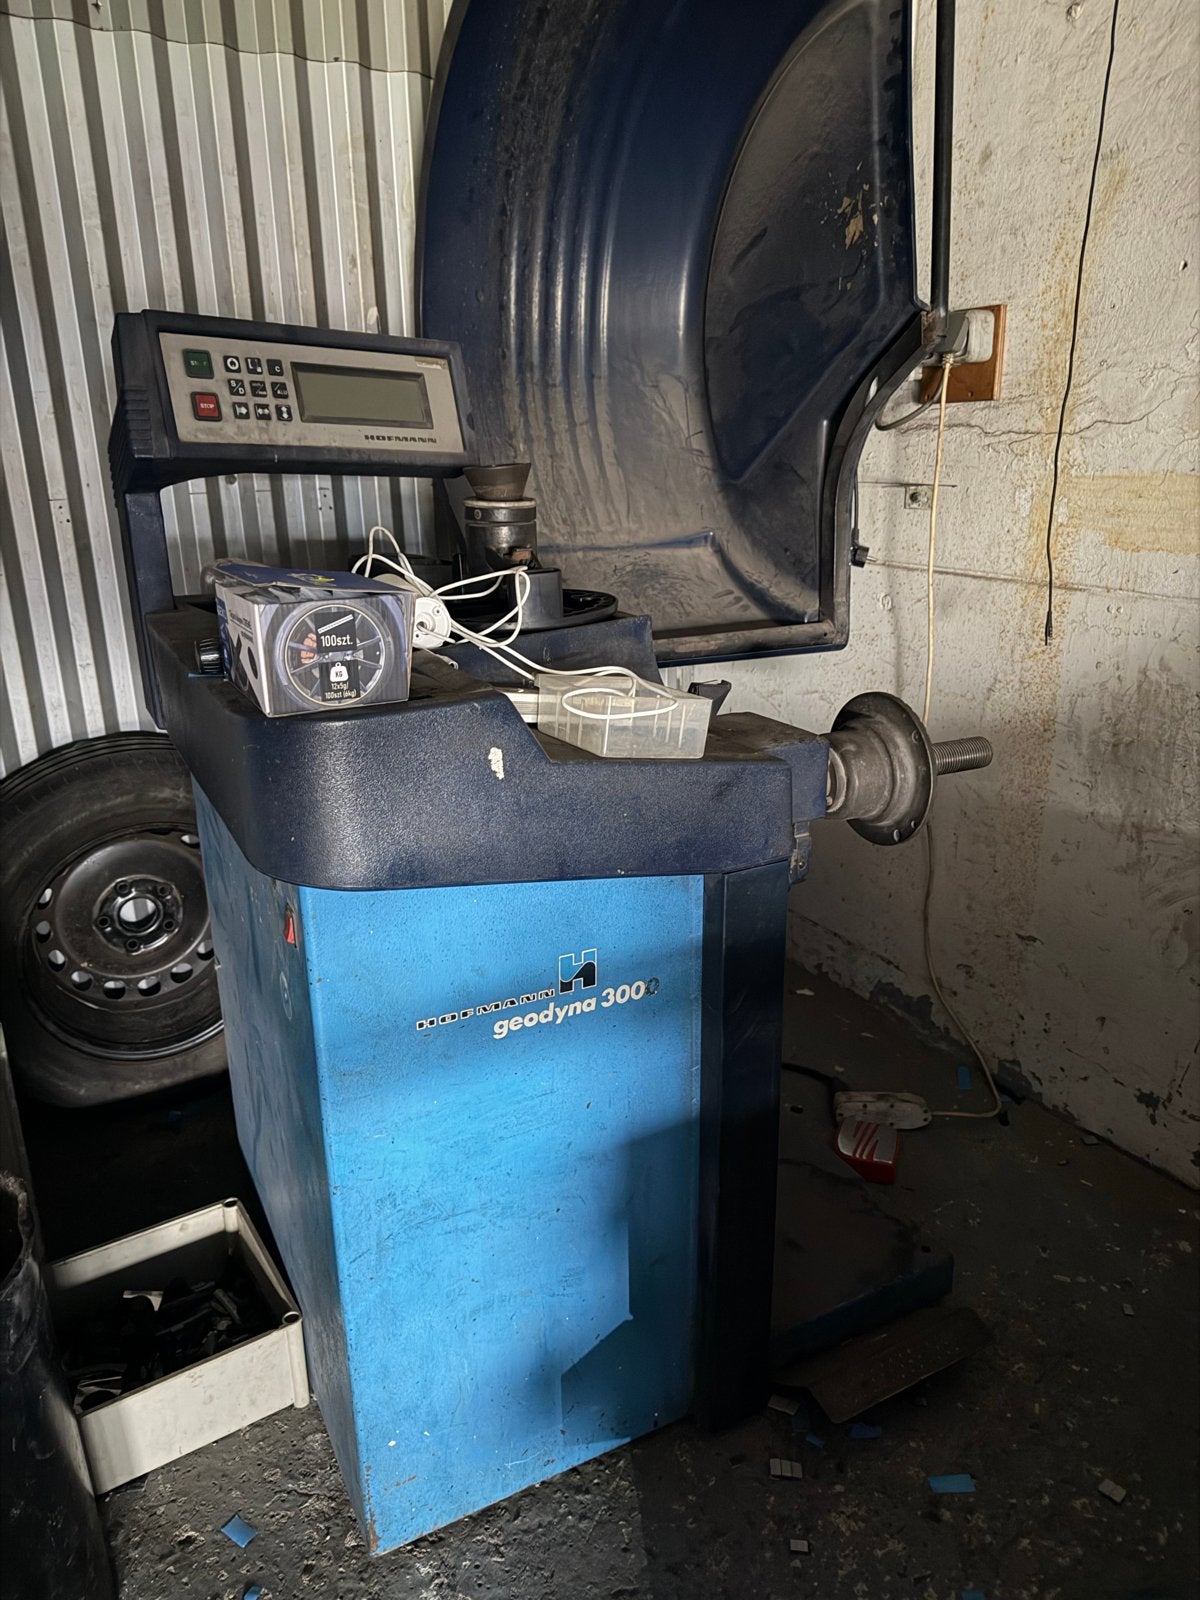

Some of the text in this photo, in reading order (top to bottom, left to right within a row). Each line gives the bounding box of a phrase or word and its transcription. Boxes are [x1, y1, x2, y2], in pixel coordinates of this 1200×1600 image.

[364, 434, 437, 443] HOFMANN
[320, 634, 353, 647] 100szt.
[325, 691, 343, 699] 100szt
[416, 988, 556, 1031] HOFMANN
[492, 996, 597, 1039] geodyna
